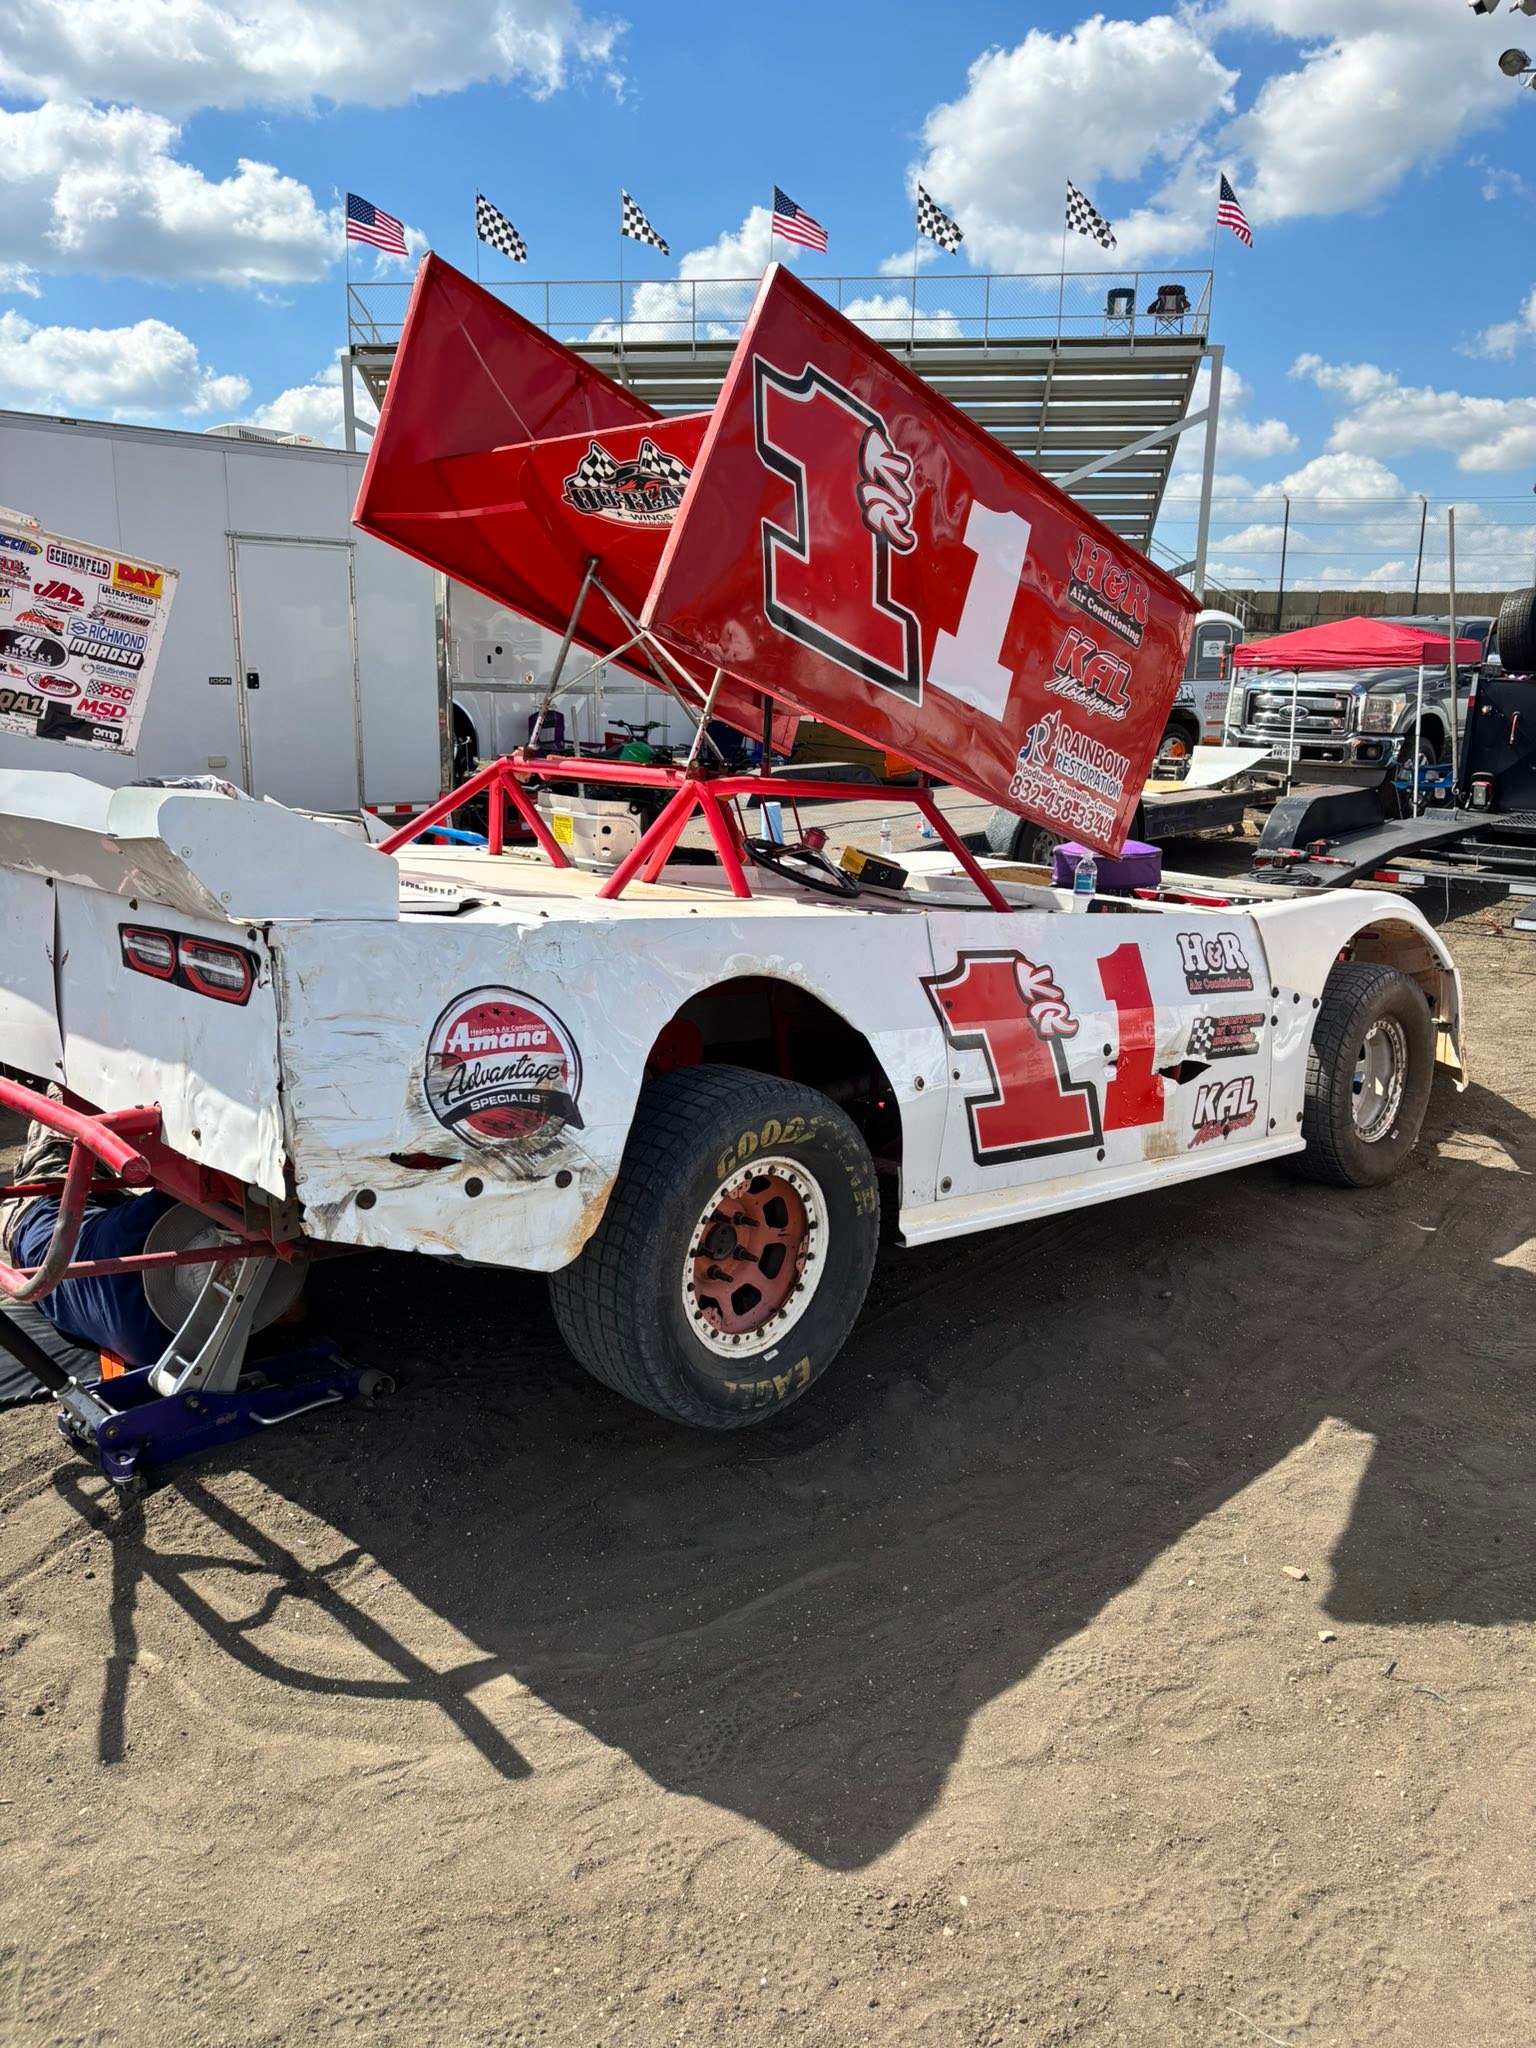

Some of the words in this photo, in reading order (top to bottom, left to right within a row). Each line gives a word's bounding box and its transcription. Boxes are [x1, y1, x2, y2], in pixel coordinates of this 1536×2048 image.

[630, 512, 672, 521] WINGS
[50, 548, 107, 576] SCHOENFELD
[118, 563, 160, 588] DAY
[34, 580, 84, 607] JAZ
[1072, 535, 1149, 624] H&R
[104, 609, 150, 627] FRANKLAND
[926, 499, 1031, 722] 1
[1070, 586, 1087, 607] Air
[1087, 597, 1141, 645] Conditioning
[14, 635, 45, 651] 41
[70, 637, 141, 666] MOROSO
[89, 624, 145, 649] RICHMOND
[5, 645, 53, 662] SHOCKS
[1054, 627, 1132, 706] KAL
[98, 682, 133, 701] PSC
[1045, 672, 1125, 721] Motorsports
[76, 698, 127, 718] MSD
[92, 728, 120, 742] omp
[1058, 723, 1130, 781] RAINBOW
[1016, 761, 1055, 789] Woodlands
[1058, 780, 1090, 805] Huntsville
[1094, 797, 1116, 818] Conroe
[1053, 752, 1123, 801] RESTORATION
[1009, 775, 1113, 842] 832-458-3344
[1176, 932, 1249, 974] H&R
[1190, 978, 1202, 990] Air
[1203, 976, 1252, 989] Conditioning
[447, 1022, 547, 1053] Amana
[470, 1028, 495, 1037] Heating
[511, 1023, 546, 1031] Conditioning
[1097, 943, 1164, 1131] 1
[919, 949, 1104, 1166] 1
[440, 1054, 560, 1106] Advantage
[1192, 1075, 1258, 1130] KAL
